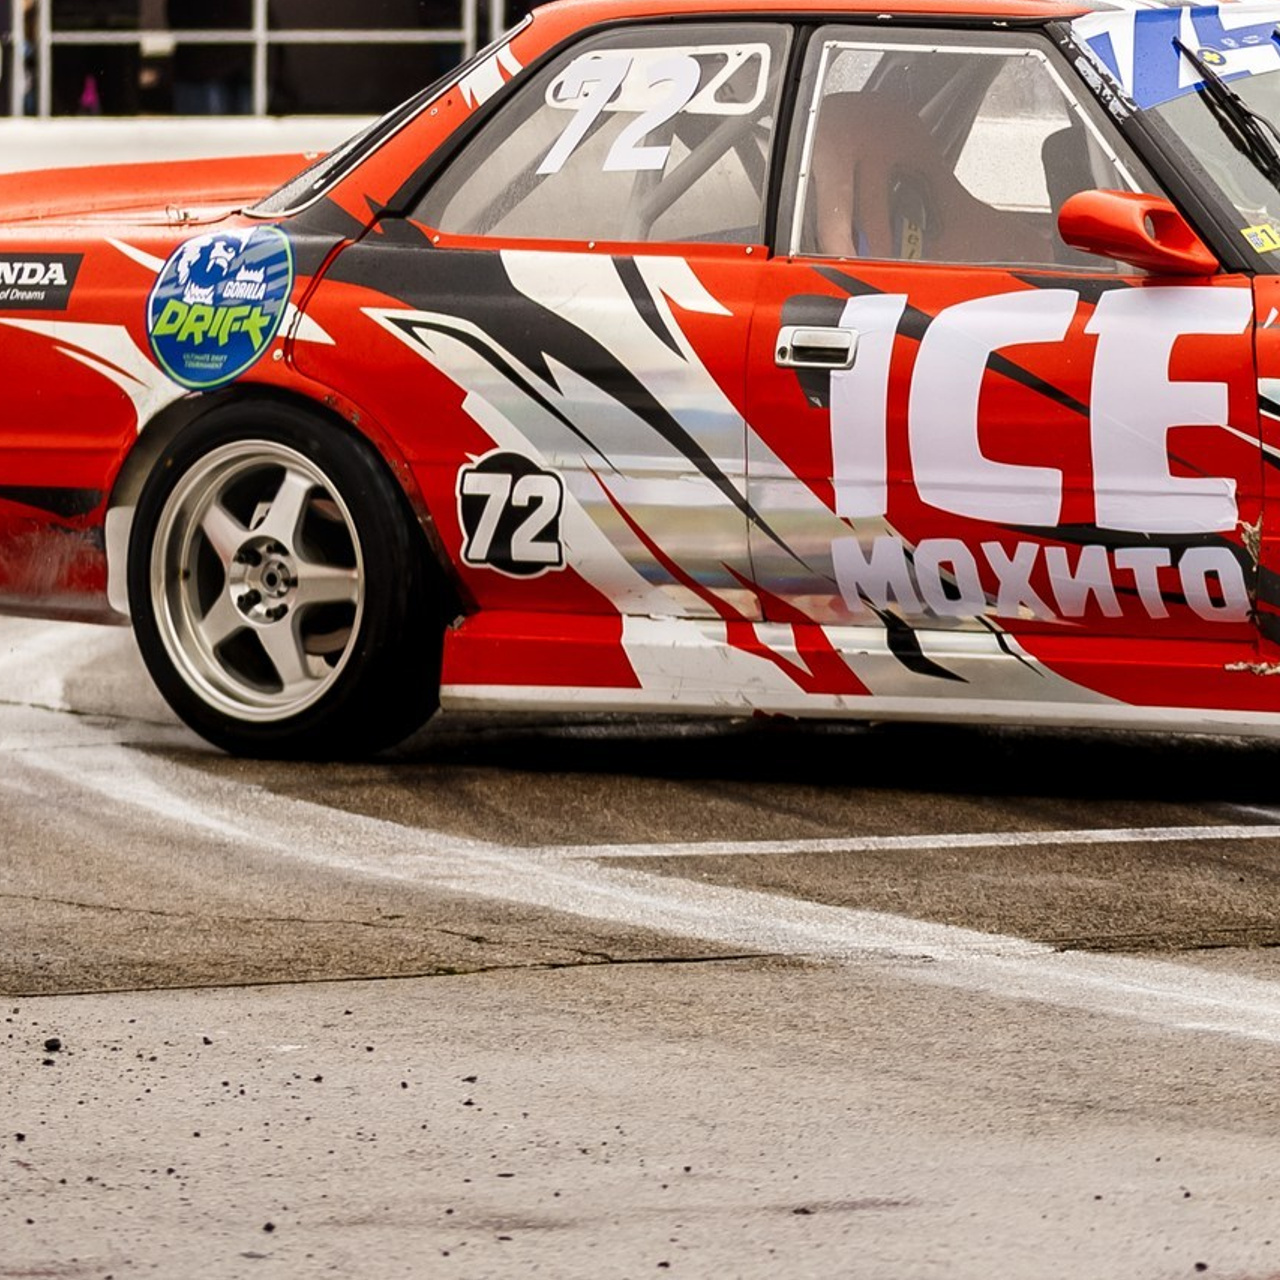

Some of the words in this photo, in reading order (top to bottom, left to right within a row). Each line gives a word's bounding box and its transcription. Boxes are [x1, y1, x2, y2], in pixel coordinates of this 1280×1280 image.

[537, 55, 701, 175] 72
[10, 288, 46, 301] Dreams
[151, 298, 272, 351] DRIFT
[222, 280, 267, 300] GORILLA
[830, 286, 1254, 534] ICE
[463, 472, 560, 562] 72
[830, 535, 1252, 622] МОХИТО
